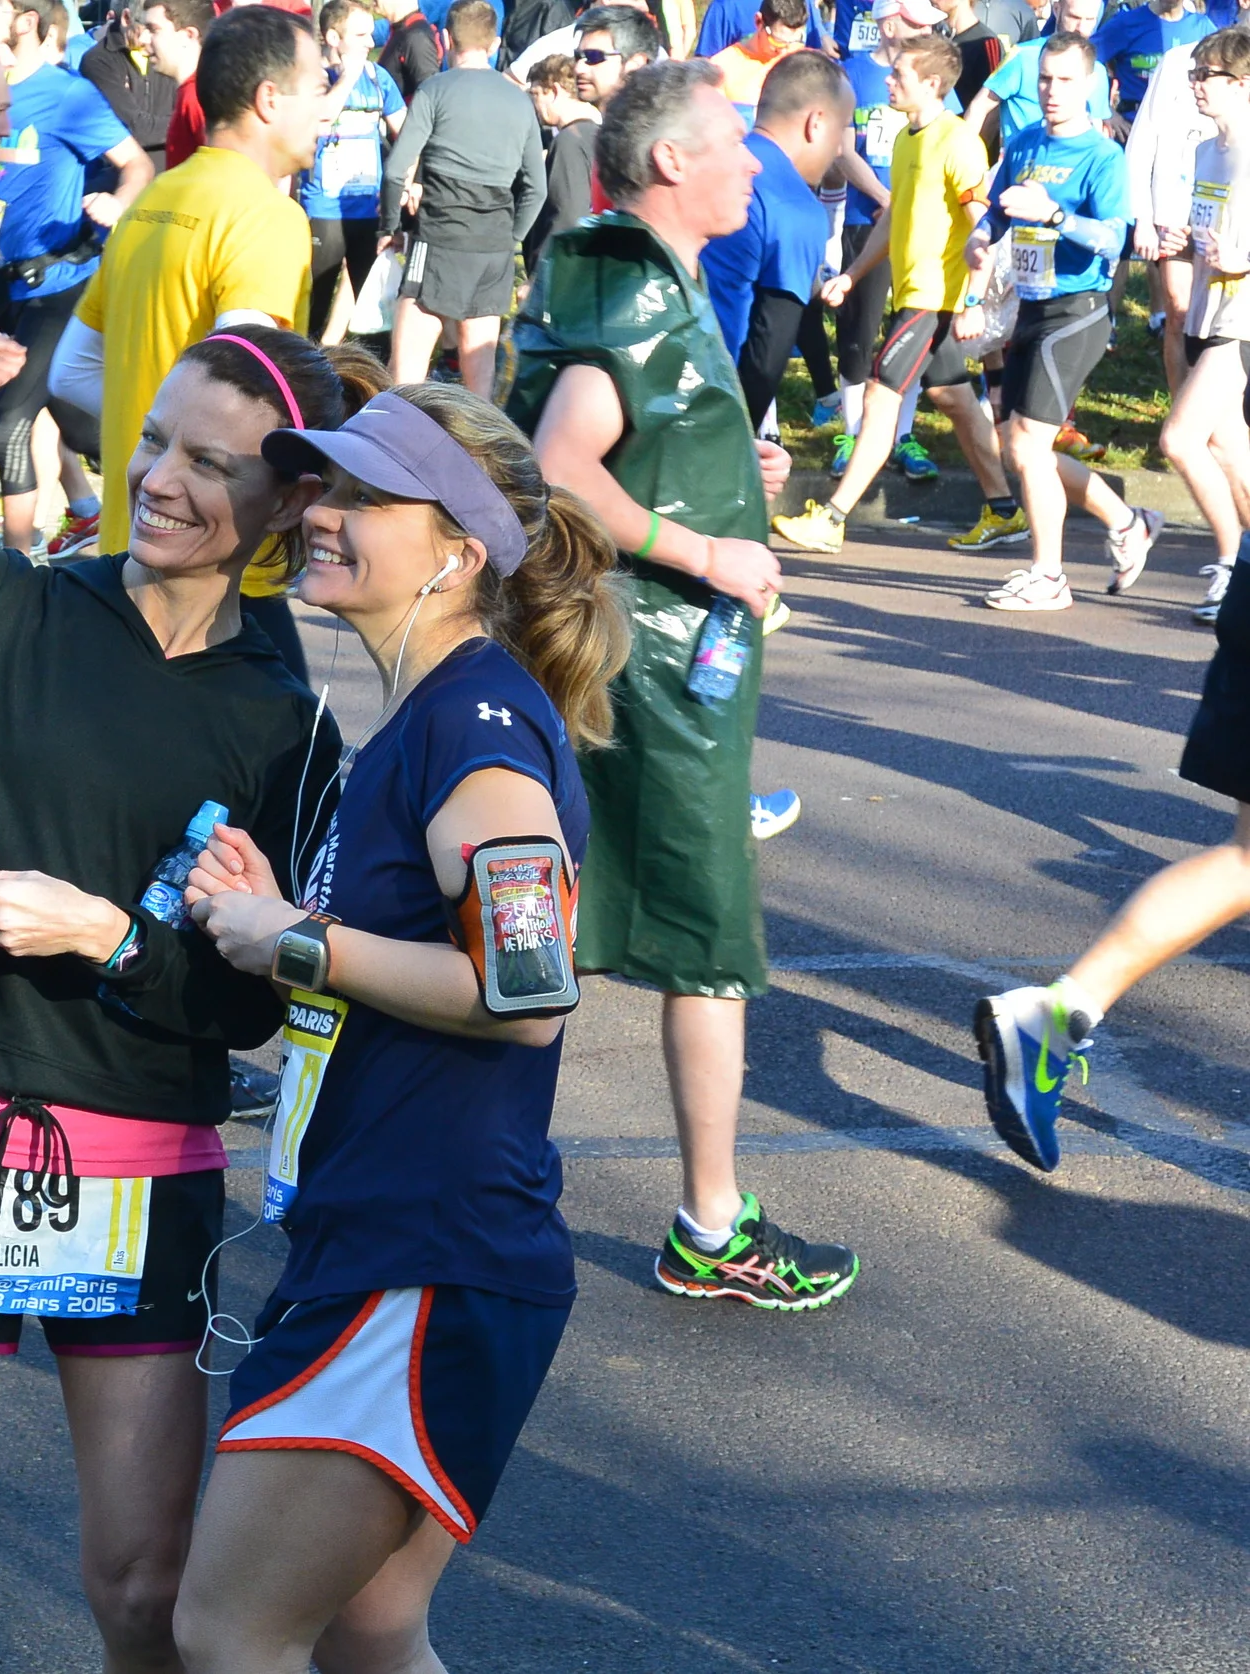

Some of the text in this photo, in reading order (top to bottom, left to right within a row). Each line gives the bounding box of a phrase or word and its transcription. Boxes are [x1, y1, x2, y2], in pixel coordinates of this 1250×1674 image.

[289, 1004, 334, 1034] PARIS
[11, 1297, 59, 1312] mars
[67, 1296, 116, 1313] 2015
